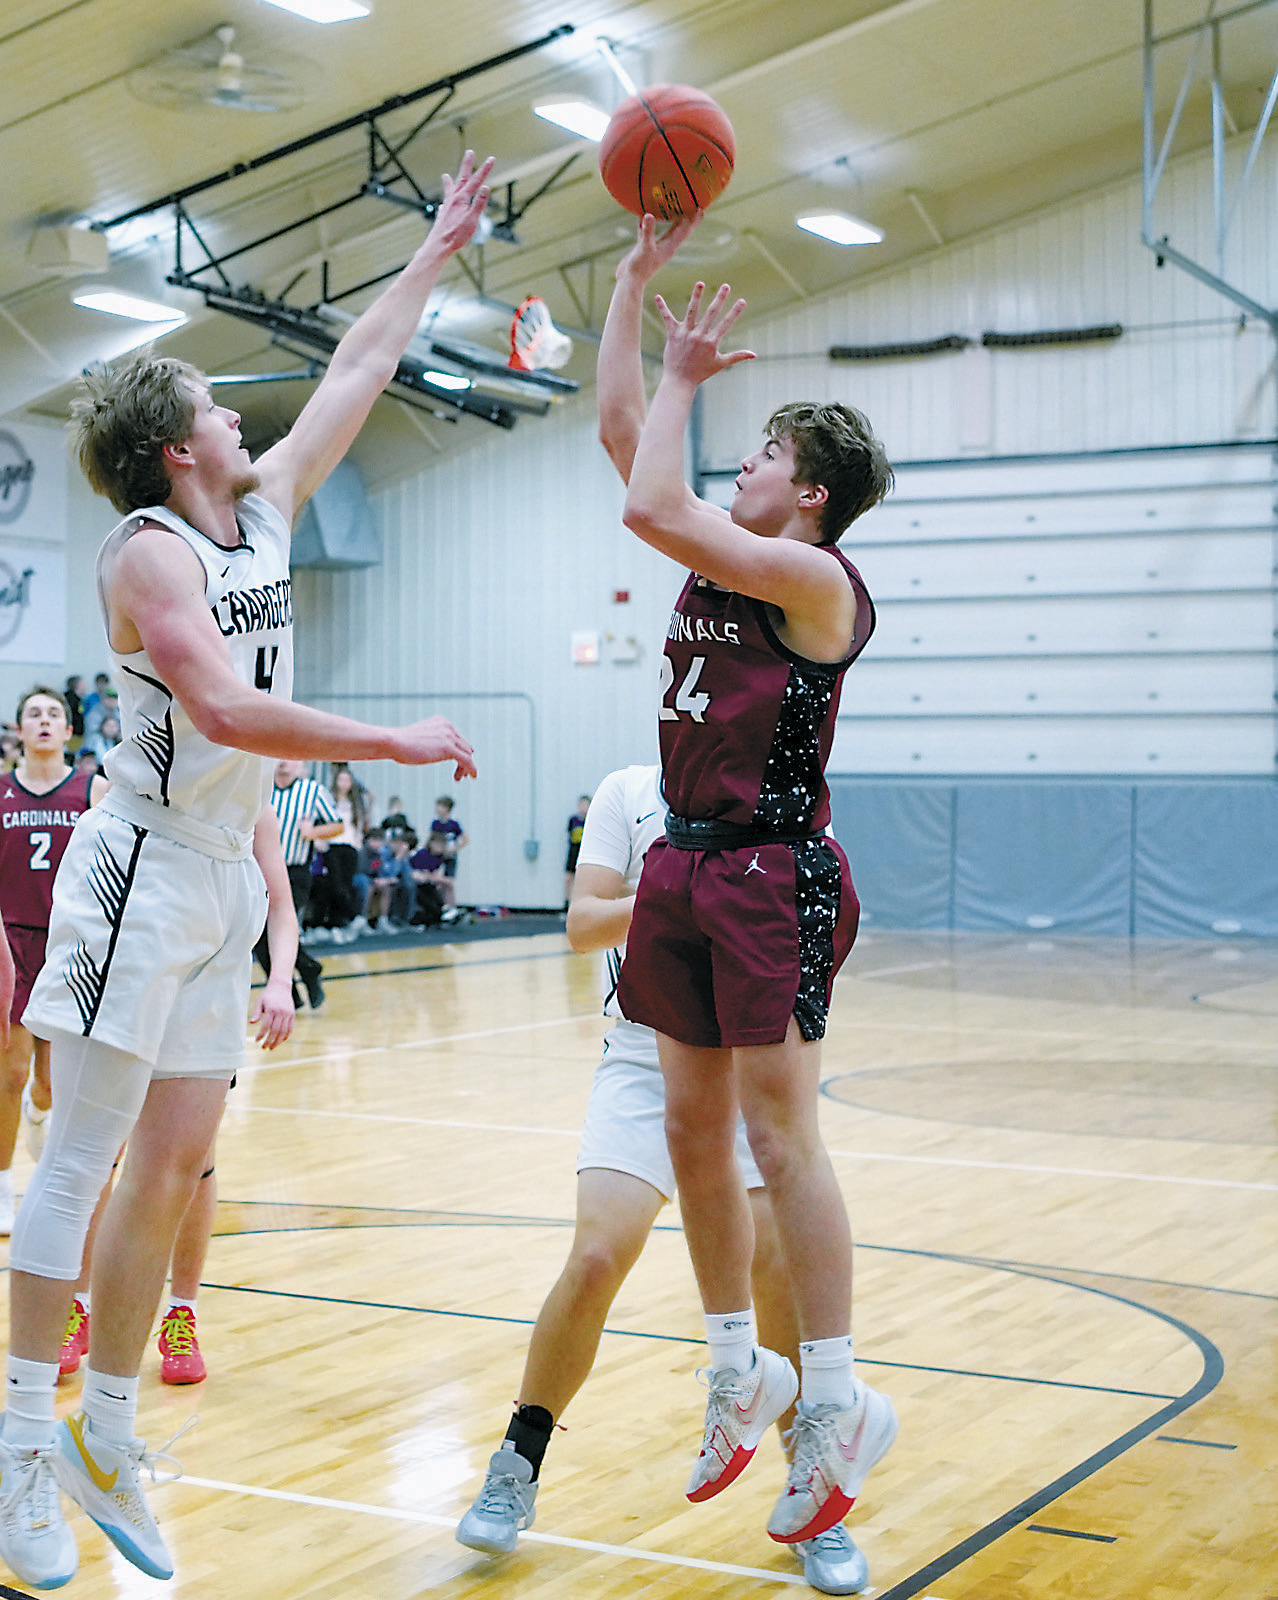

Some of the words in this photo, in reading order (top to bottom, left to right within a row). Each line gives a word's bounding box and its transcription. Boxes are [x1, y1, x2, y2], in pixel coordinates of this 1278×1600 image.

[211, 579, 292, 636] CHARGER
[254, 646, 279, 694] 4
[659, 652, 710, 723] 24
[2, 809, 79, 829] CARDINALS
[29, 831, 51, 870] 2
